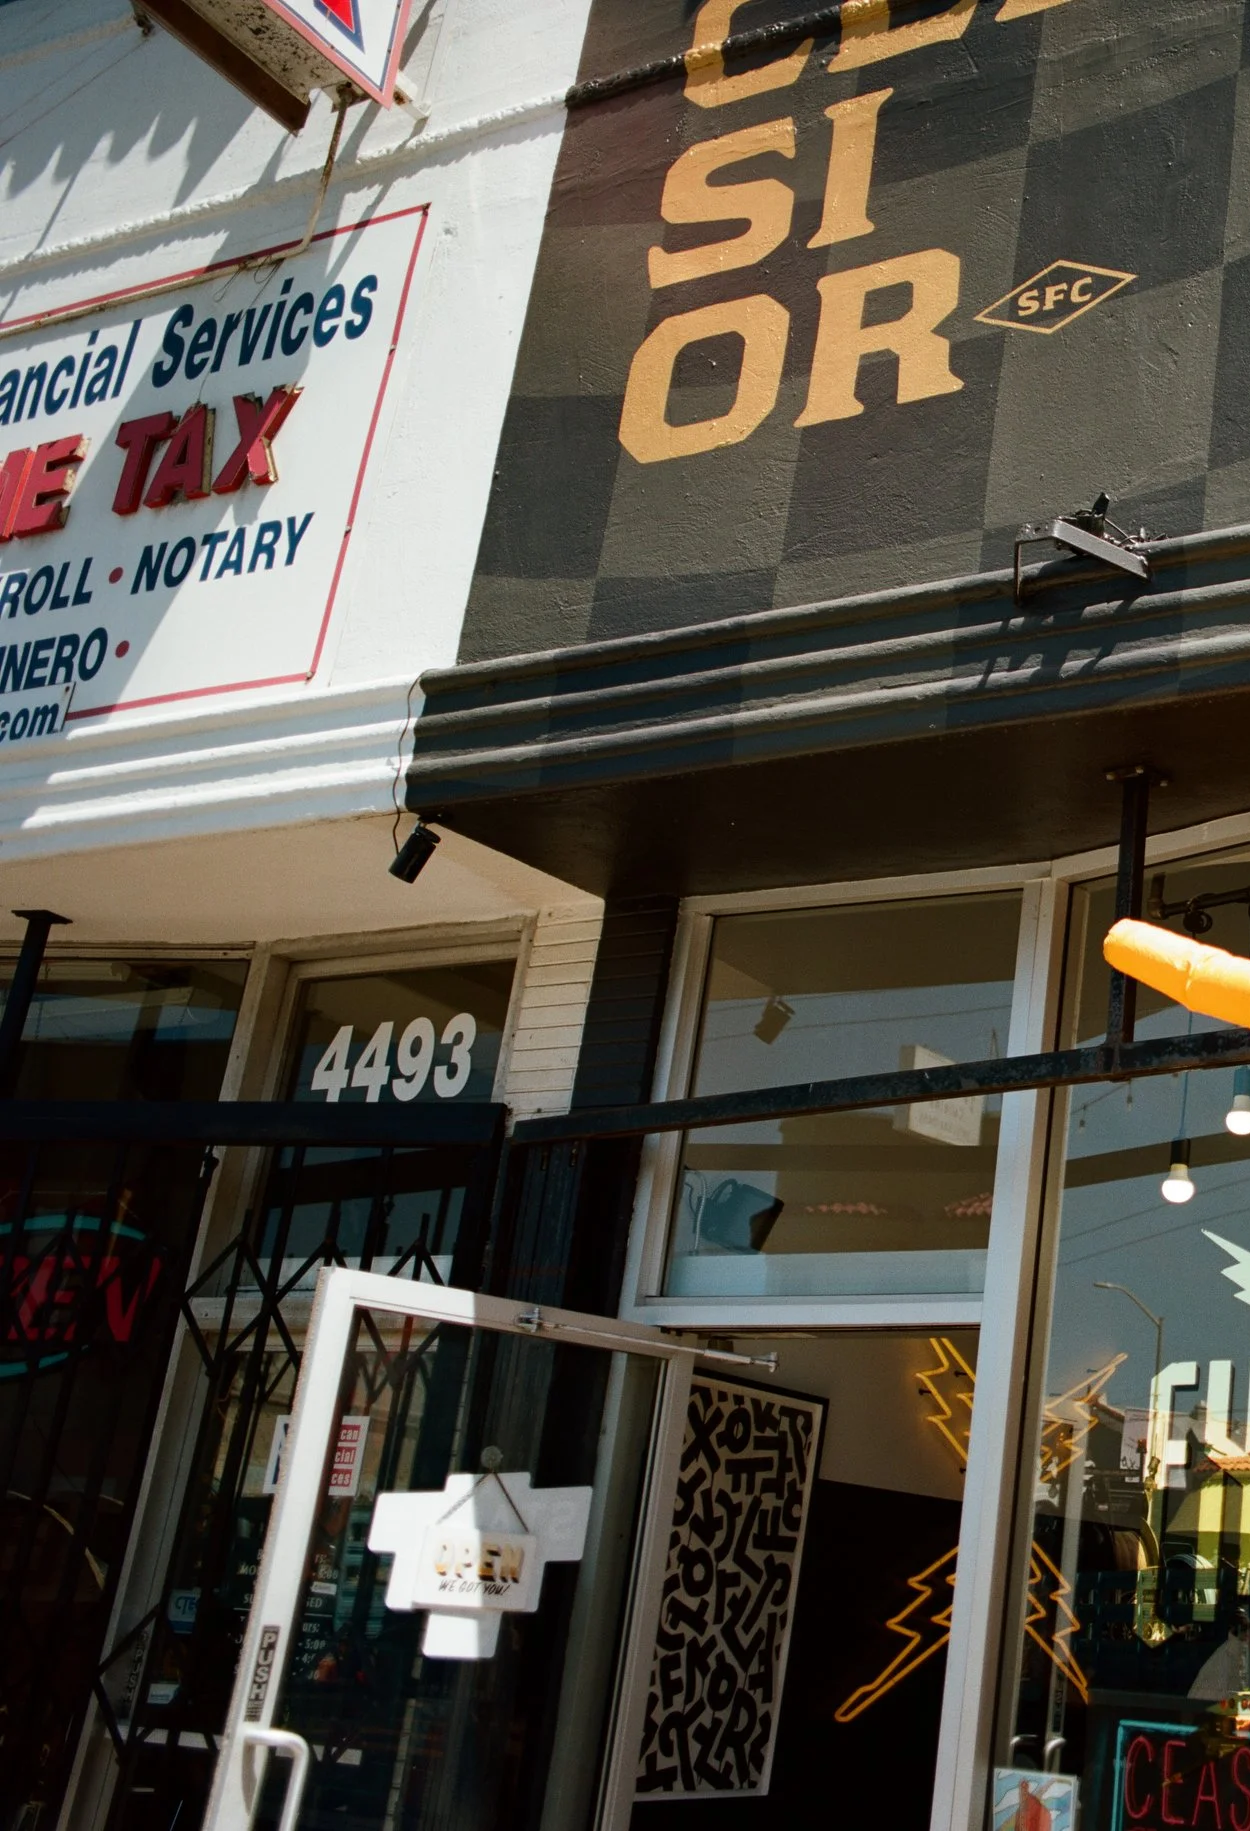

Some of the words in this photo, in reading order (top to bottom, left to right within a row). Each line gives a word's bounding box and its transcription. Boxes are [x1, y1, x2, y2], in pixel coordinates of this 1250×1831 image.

[647, 87, 894, 289] SI
[151, 274, 379, 389] Services
[1017, 276, 1093, 317] SFC
[618, 248, 965, 464] OR
[111, 380, 305, 517] TAX
[129, 511, 316, 596] NOTARY
[310, 1012, 477, 1103] 4493
[250, 1631, 277, 1700] PUSH
